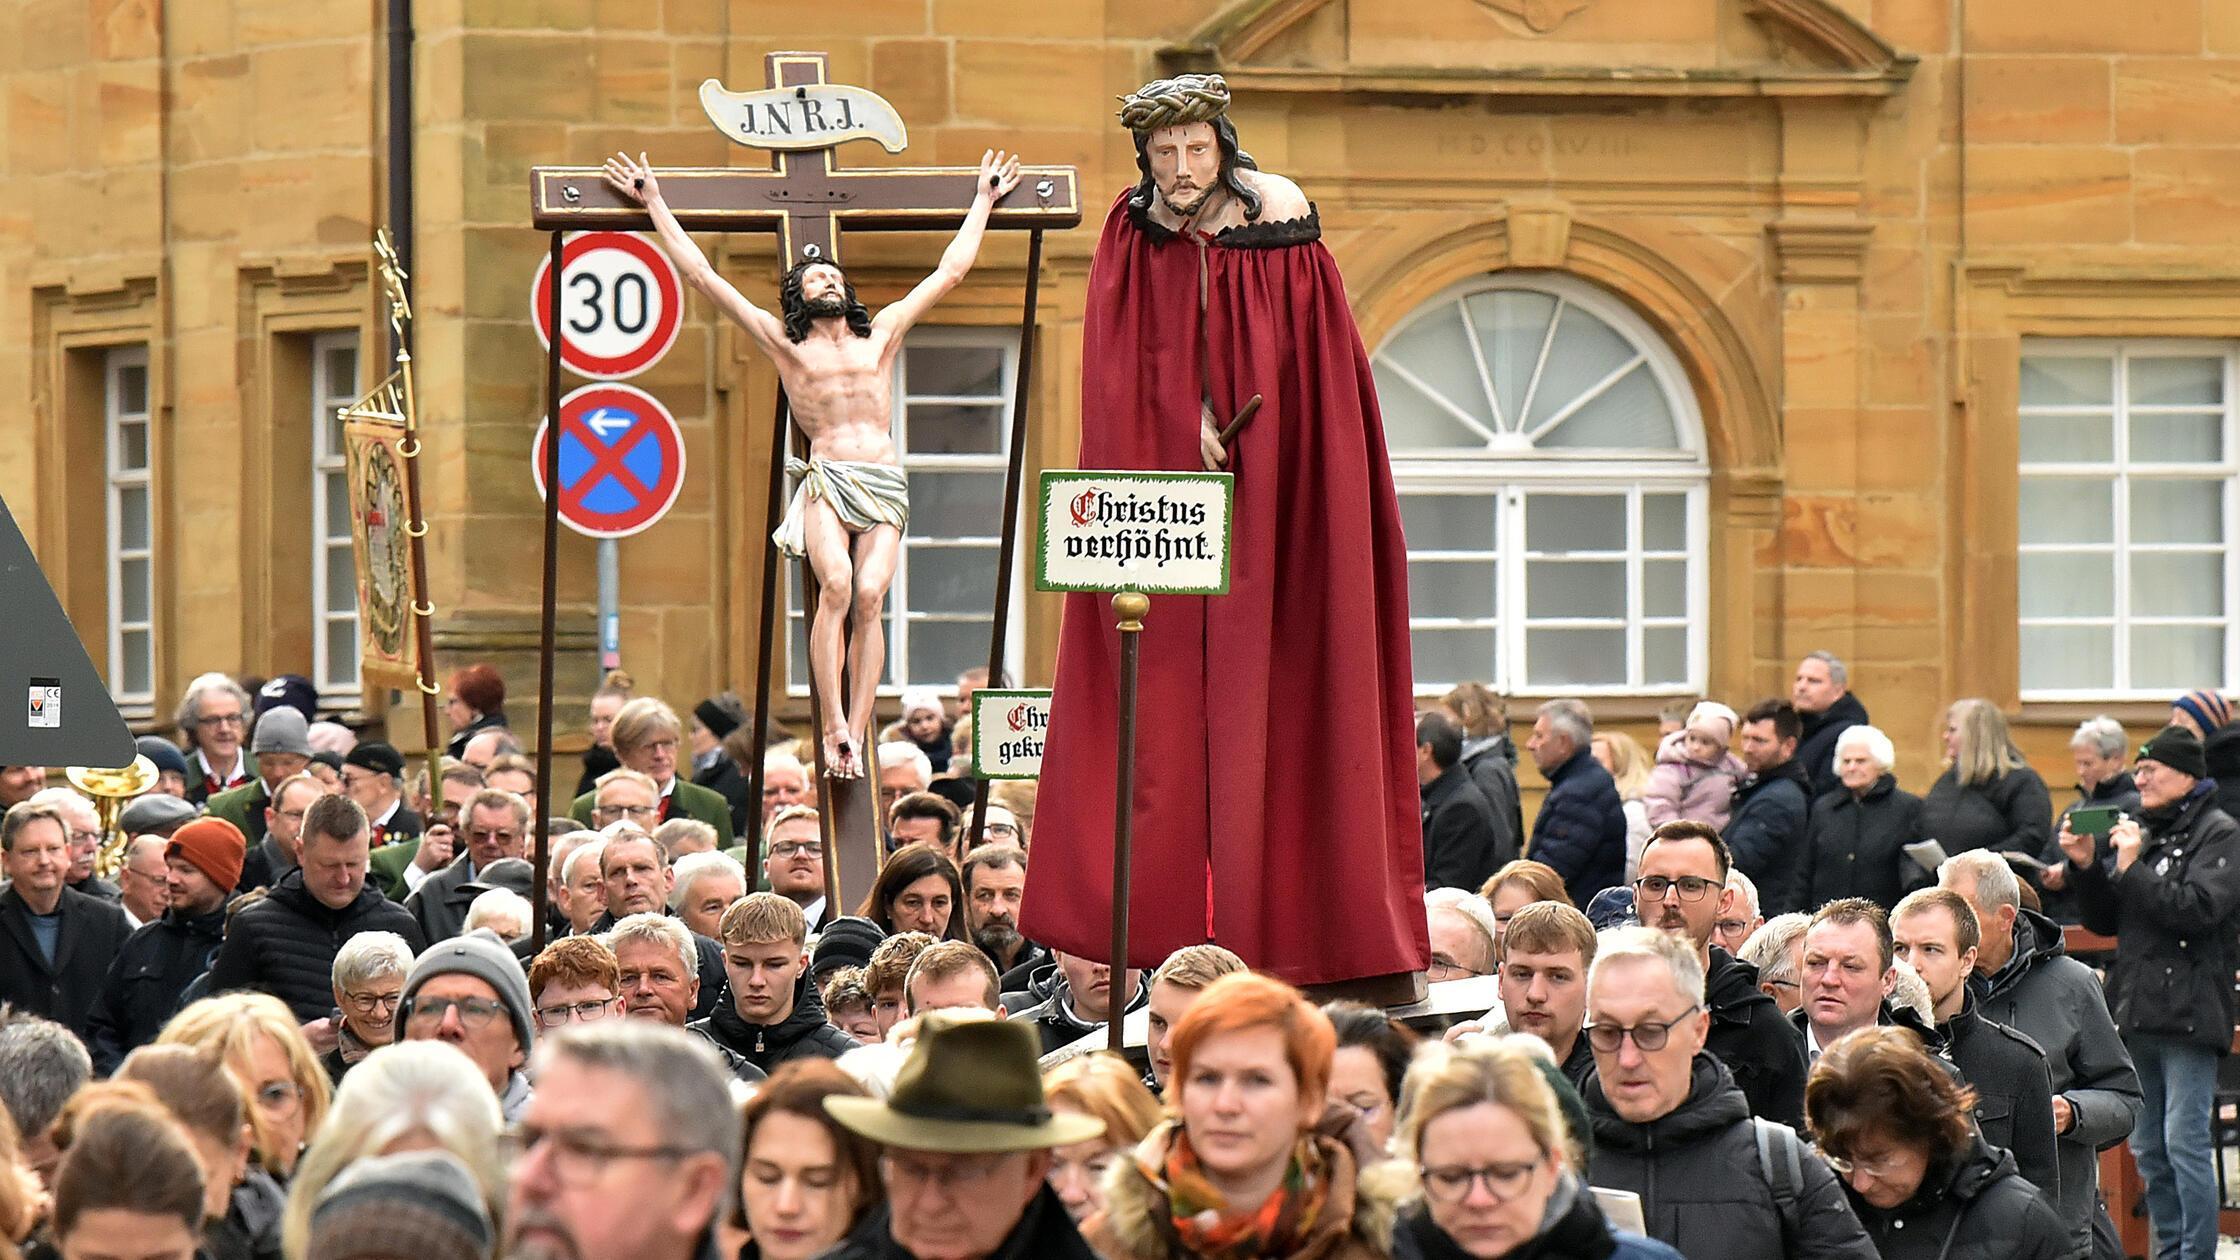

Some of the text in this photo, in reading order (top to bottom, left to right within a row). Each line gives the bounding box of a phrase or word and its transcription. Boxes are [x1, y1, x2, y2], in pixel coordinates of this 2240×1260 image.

[569, 272, 648, 334] 30
[1069, 486, 1206, 528] Christus
[1063, 528, 1216, 567] verhöhnt.
